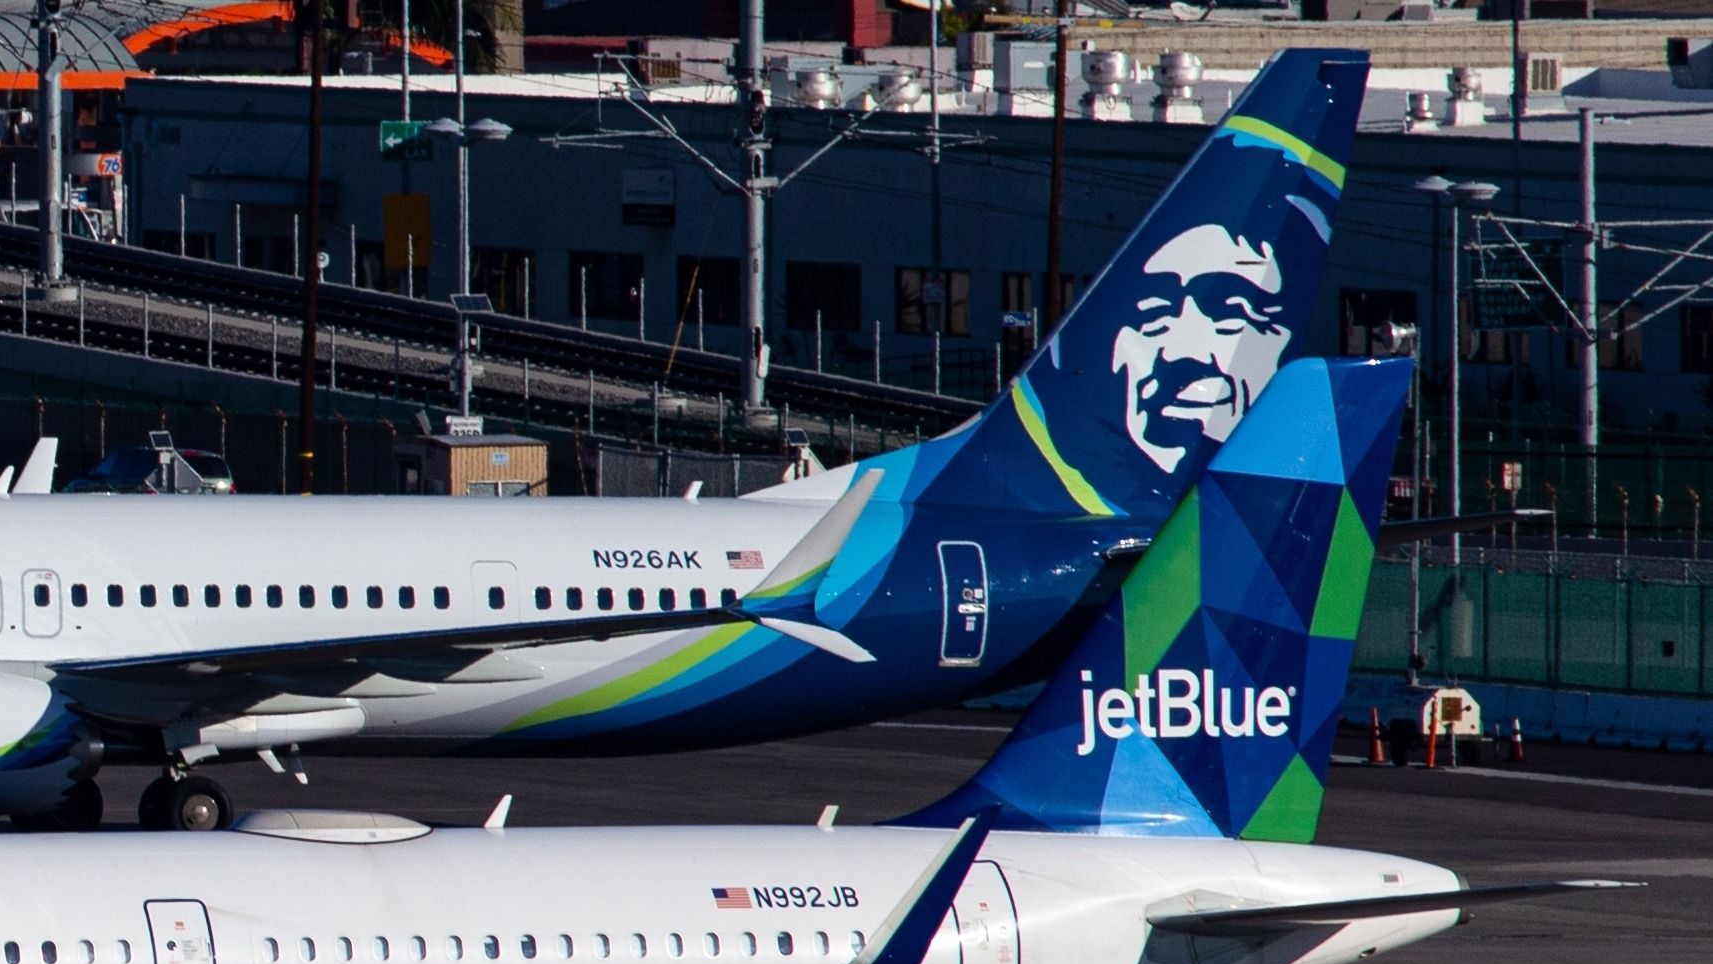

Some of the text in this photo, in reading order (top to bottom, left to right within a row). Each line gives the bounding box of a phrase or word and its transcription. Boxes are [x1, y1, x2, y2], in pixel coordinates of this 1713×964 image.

[103, 158, 121, 173] 76
[592, 549, 703, 569] N926AK
[752, 886, 860, 909] N992JB
